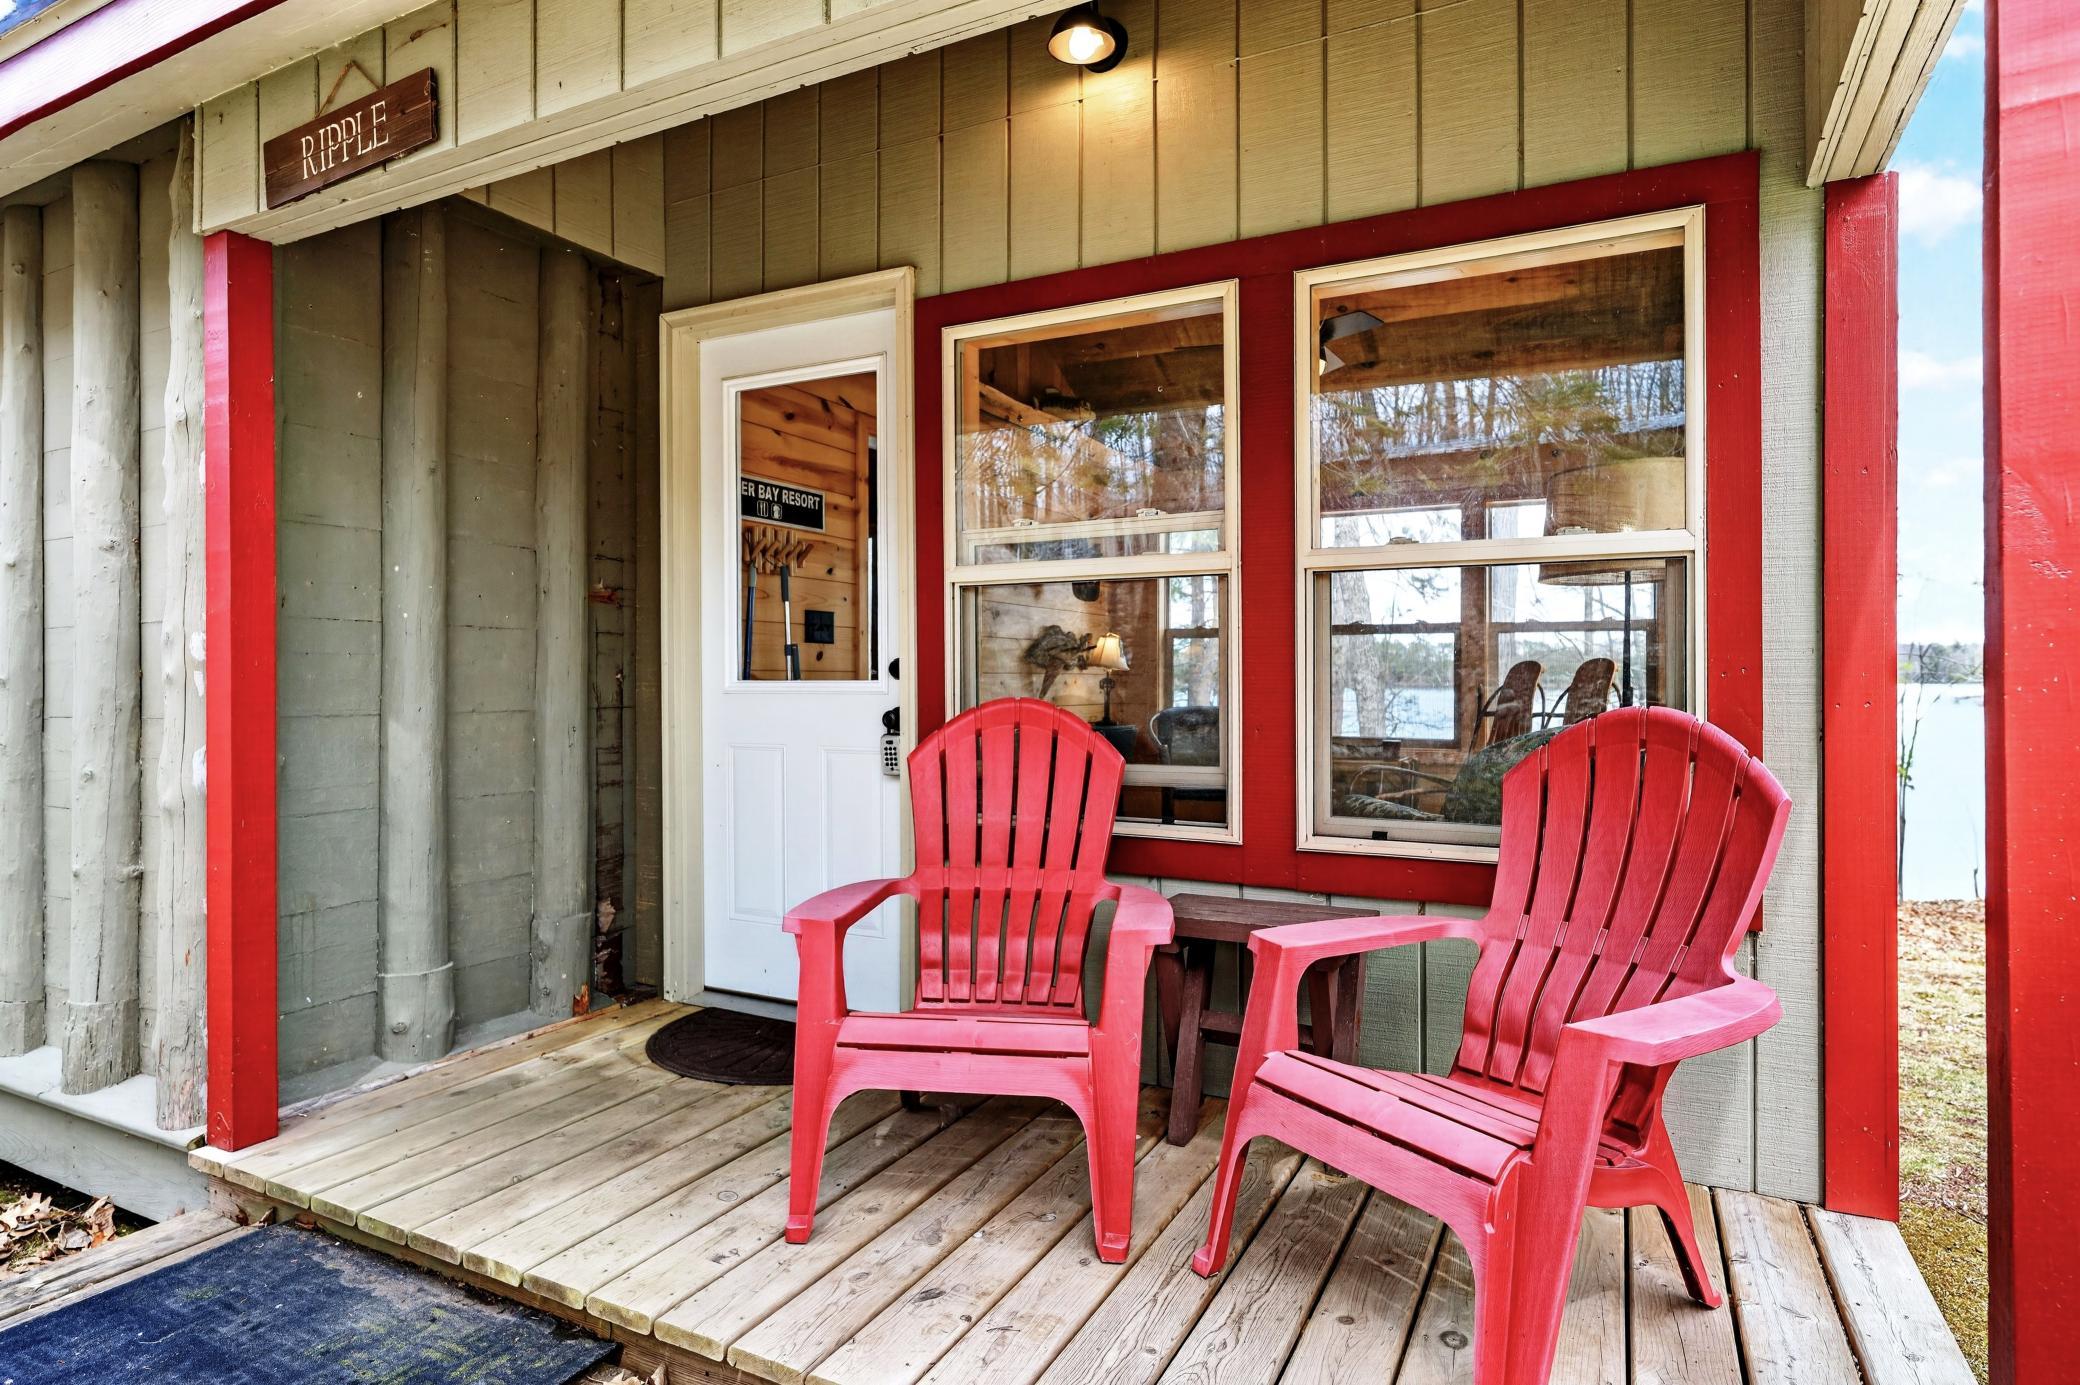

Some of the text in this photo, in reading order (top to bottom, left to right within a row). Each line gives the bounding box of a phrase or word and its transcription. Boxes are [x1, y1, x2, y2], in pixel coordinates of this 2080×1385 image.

[300, 100, 389, 180] RIPPLE
[758, 484, 779, 502] BAY
[782, 489, 820, 510] RESORT
